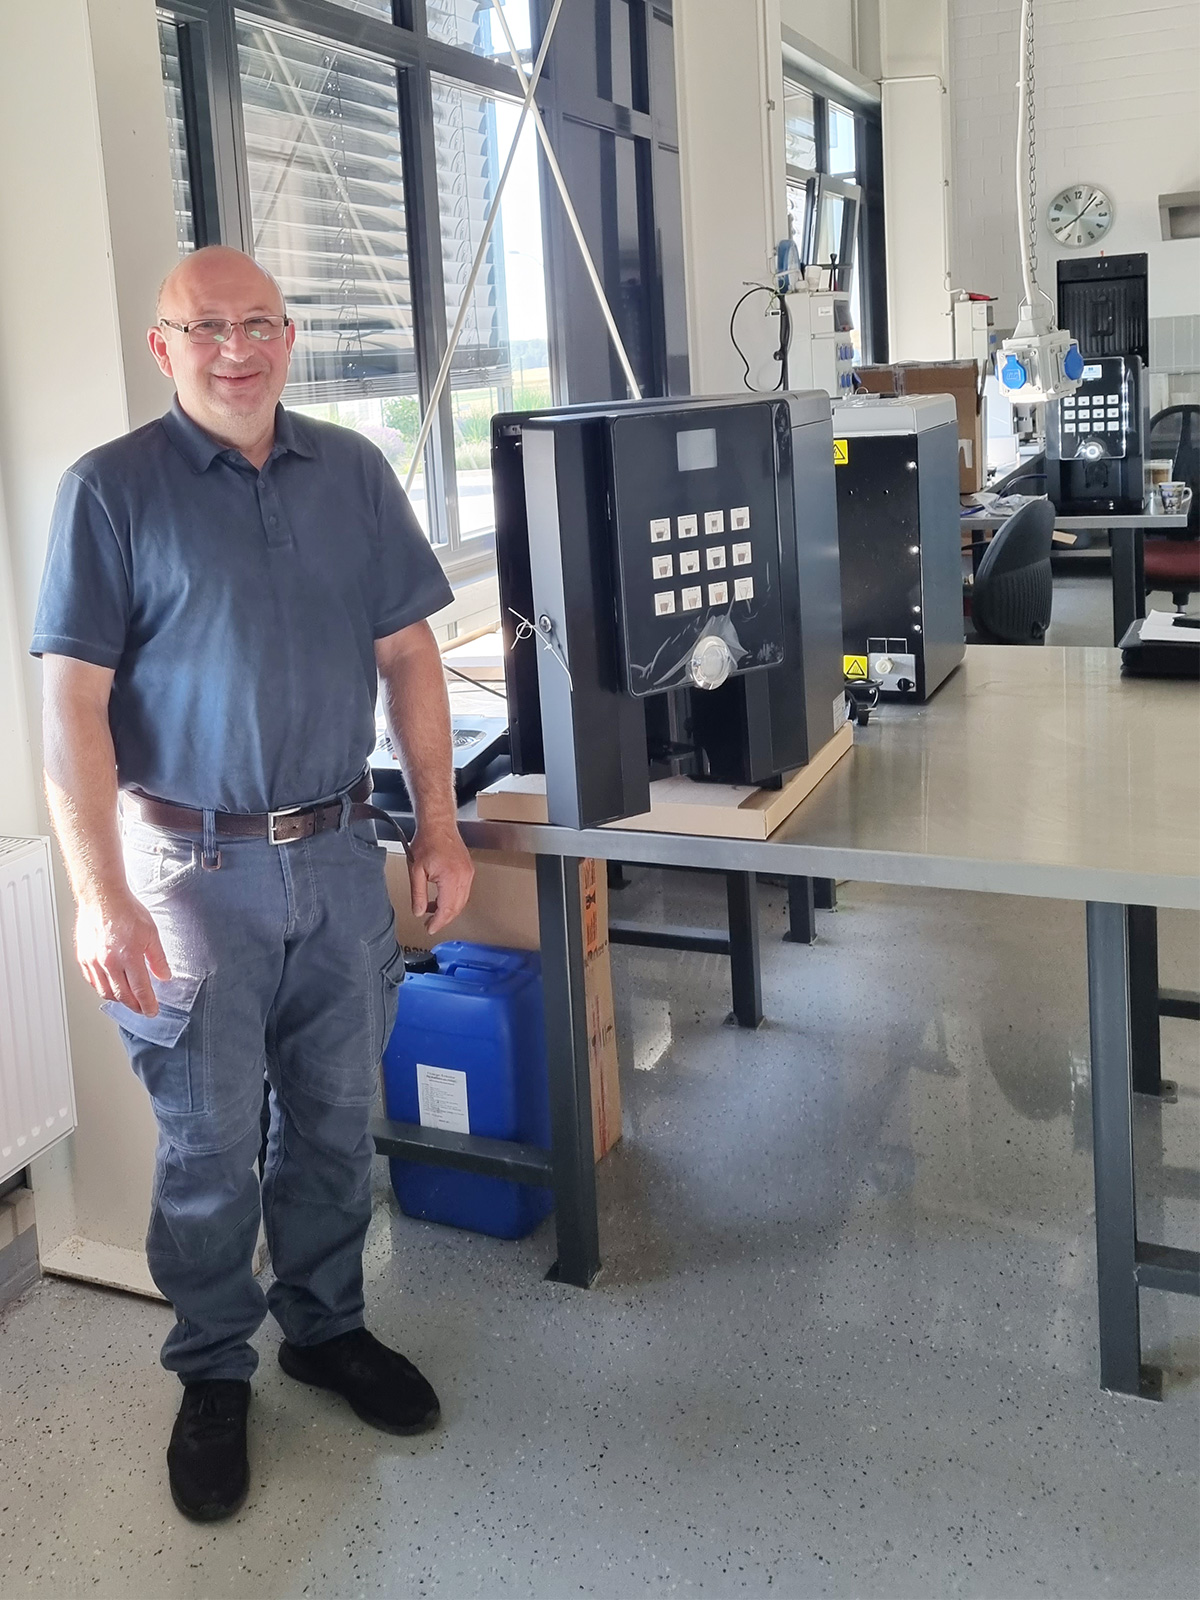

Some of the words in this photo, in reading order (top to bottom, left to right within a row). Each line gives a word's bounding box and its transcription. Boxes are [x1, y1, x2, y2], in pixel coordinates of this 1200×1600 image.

[1063, 195, 1071, 203] 11
[1074, 191, 1082, 199] 12
[1077, 235, 1082, 243] 6
[1088, 231, 1095, 239] 5
